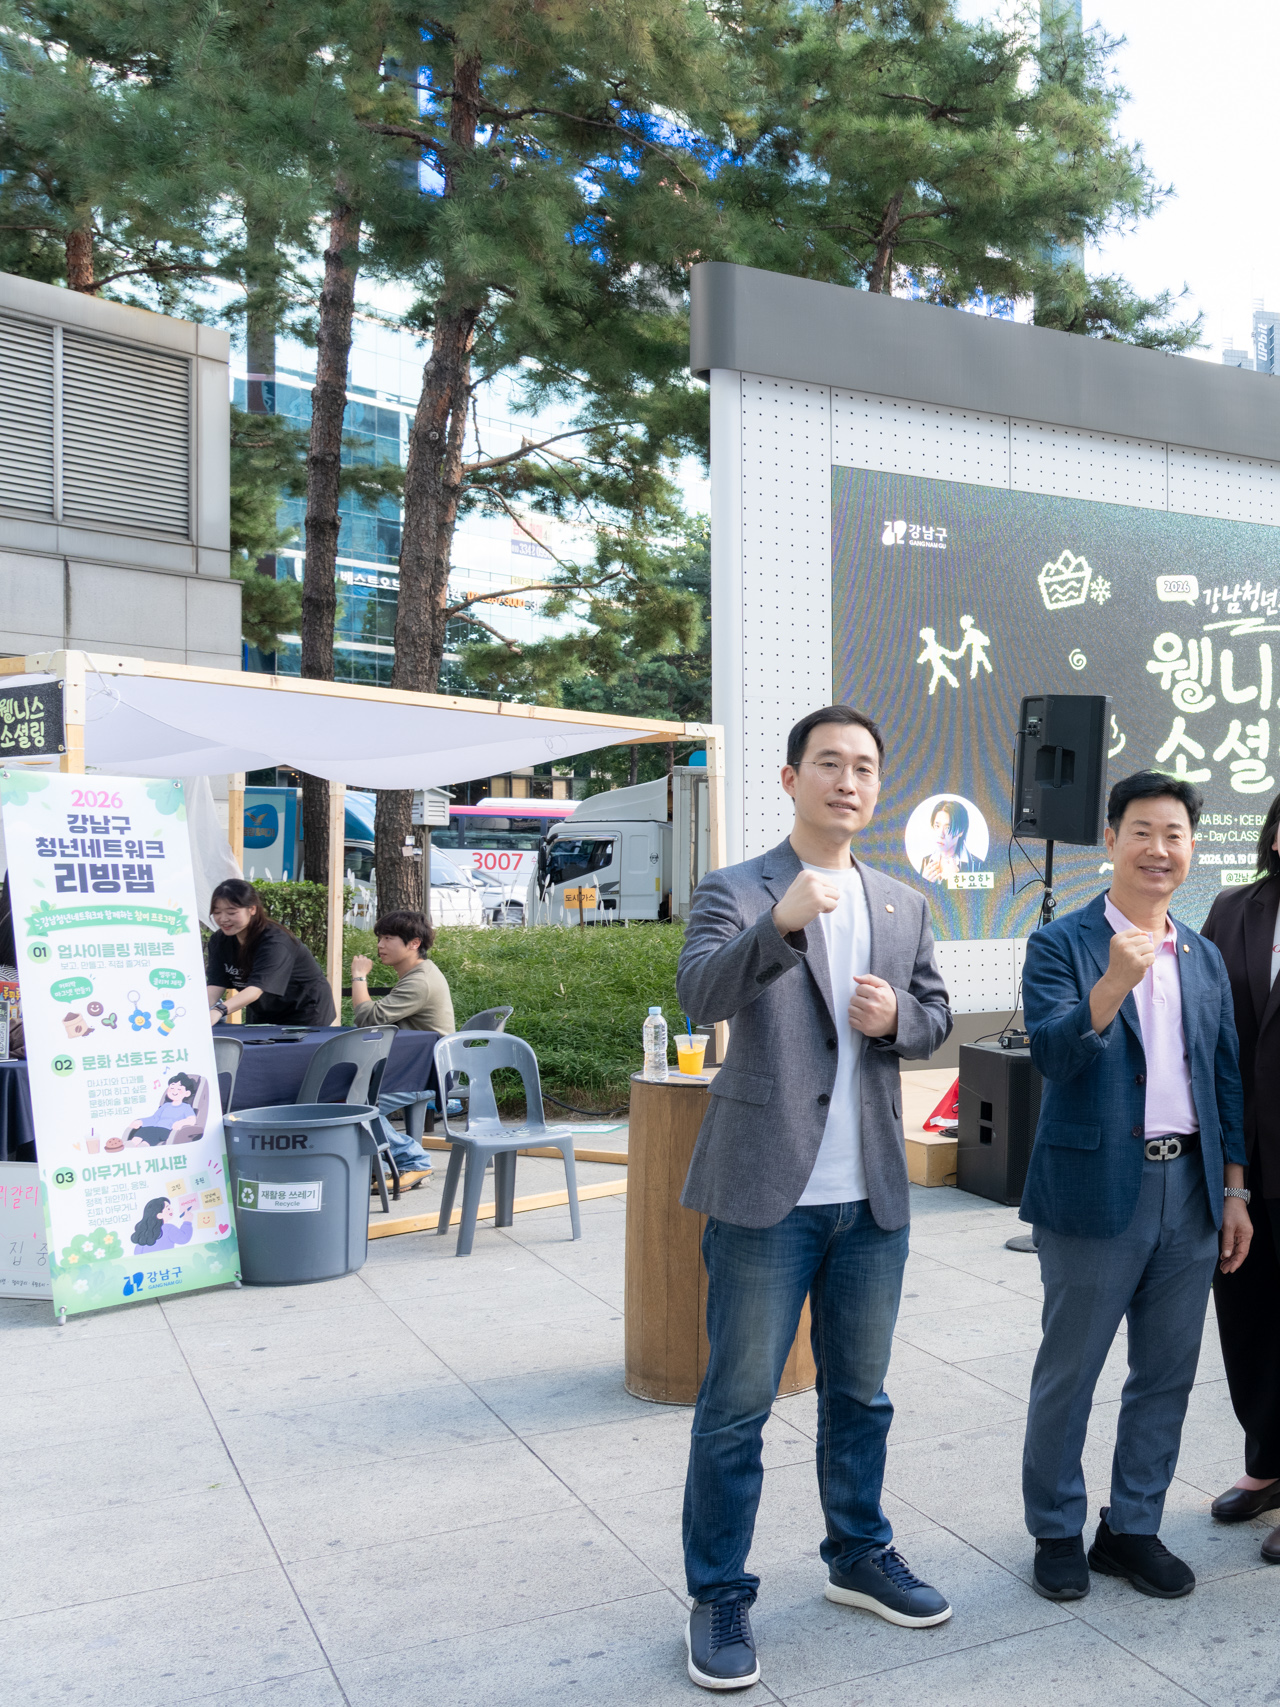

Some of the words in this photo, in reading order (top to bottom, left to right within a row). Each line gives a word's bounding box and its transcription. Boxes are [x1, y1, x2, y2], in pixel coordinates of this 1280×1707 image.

[909, 524, 948, 542] 강남구
[1164, 580, 1191, 593] 2026
[0, 721, 45, 749] 소셜링
[71, 789, 124, 809] 2026
[67, 813, 132, 835] 강남구
[1212, 814, 1233, 826] BUS
[1239, 814, 1255, 826] ICE
[1209, 831, 1227, 843] Day
[1227, 831, 1259, 841] CLASS
[35, 836, 166, 859] 청년네트워크
[472, 852, 524, 871] 3007
[53, 863, 156, 893] 리빙랩
[953, 874, 991, 889] 한요한
[565, 894, 595, 902] 도시가스
[105, 910, 133, 921] 함께하는
[134, 910, 150, 922] 참여
[150, 913, 176, 926] 프로그램
[32, 946, 47, 958] 01
[57, 943, 131, 959] 업사이클링
[133, 942, 175, 957] 체험존
[54, 1059, 73, 1071] 02
[82, 1054, 112, 1071] 문화
[115, 1051, 158, 1068] 선호도
[161, 1048, 189, 1064] 조사
[87, 1077, 119, 1088] 마사지와
[114, 1086, 130, 1096] 하고
[248, 1134, 309, 1151] THOR
[81, 1160, 142, 1182] 아무거나
[145, 1155, 188, 1174] 게시판
[55, 1171, 74, 1184] 03
[261, 1190, 287, 1200] 재활용
[288, 1190, 316, 1200] 쓰레기
[105, 1202, 138, 1216] 아무거나
[146, 1266, 183, 1283] 강남구
[148, 1281, 164, 1290] GANG
